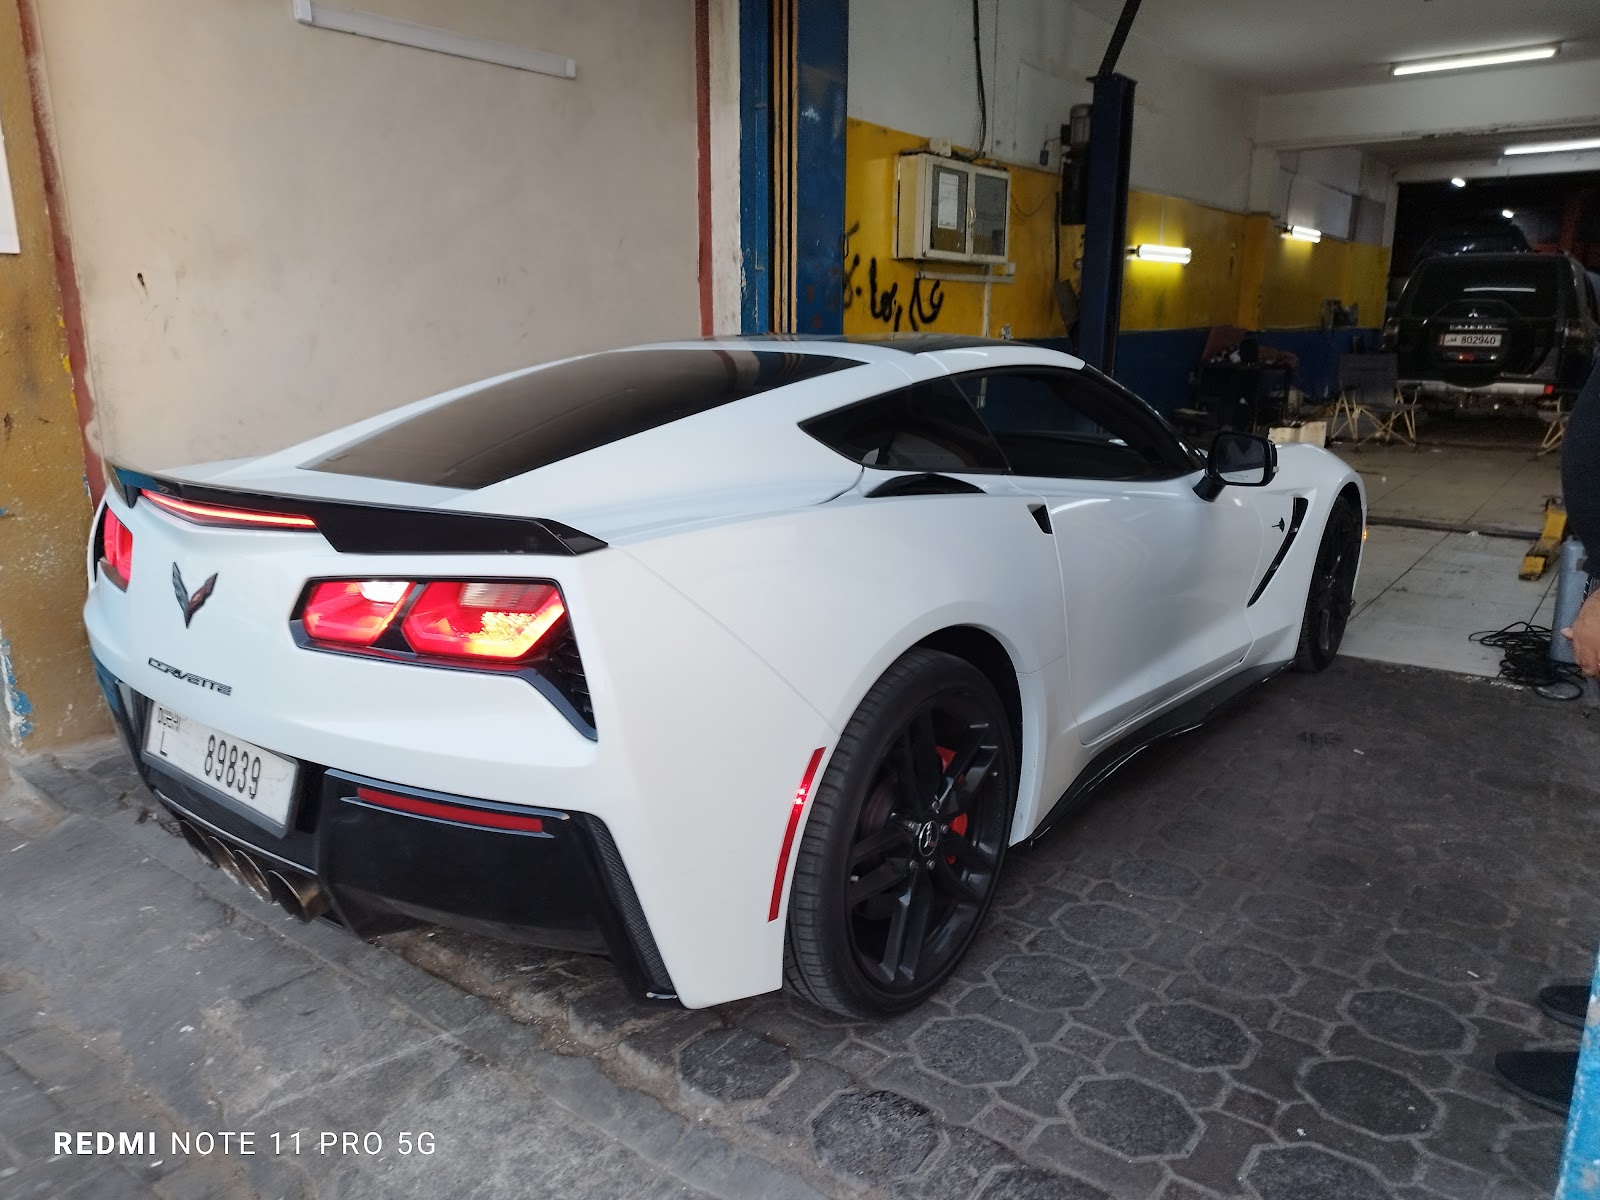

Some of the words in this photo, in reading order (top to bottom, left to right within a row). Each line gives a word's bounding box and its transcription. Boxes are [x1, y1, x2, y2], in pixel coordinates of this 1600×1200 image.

[1460, 335, 1497, 345] 802940
[147, 657, 233, 696] CORVETTE
[159, 730, 168, 757] L
[204, 734, 261, 799] 89839
